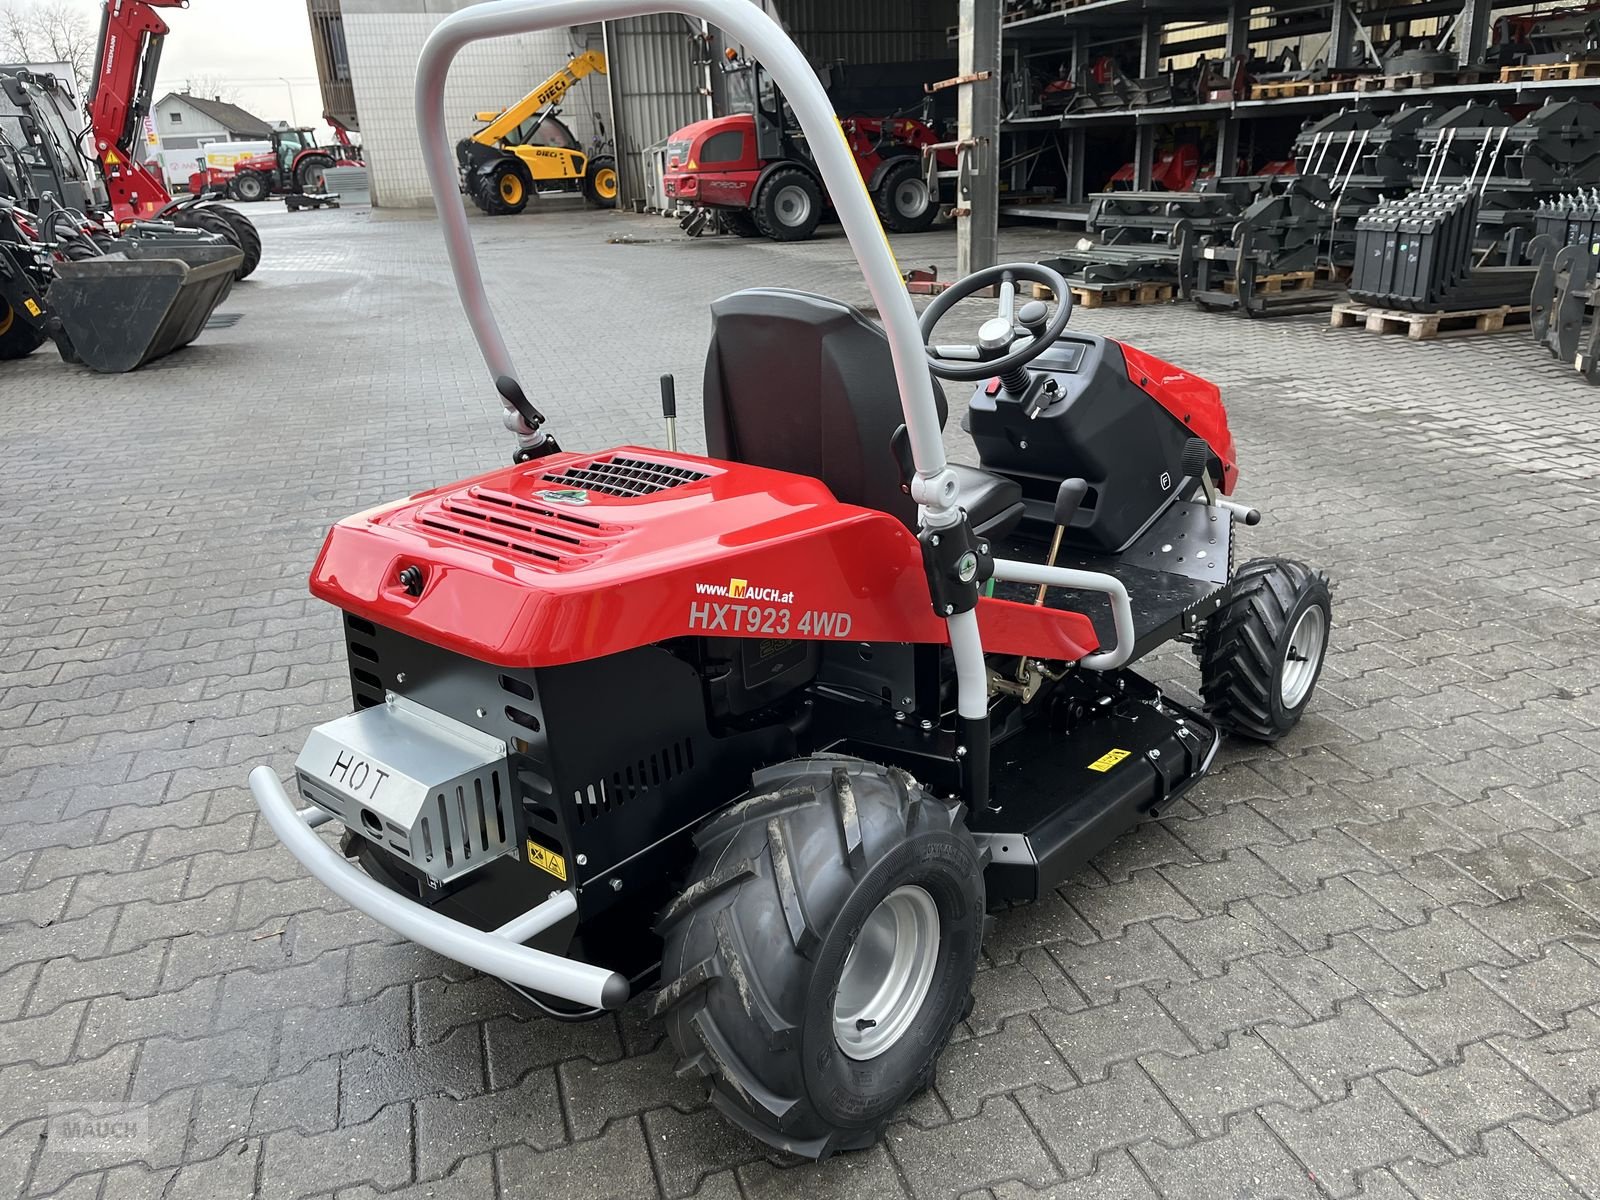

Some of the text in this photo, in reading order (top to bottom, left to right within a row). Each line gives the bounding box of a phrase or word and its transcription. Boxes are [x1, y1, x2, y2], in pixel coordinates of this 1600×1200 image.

[537, 80, 566, 105] DIECI
[695, 582, 794, 604] www.MAUCH.at
[689, 601, 852, 637] HXT923 4WD
[329, 750, 390, 800] HOT
